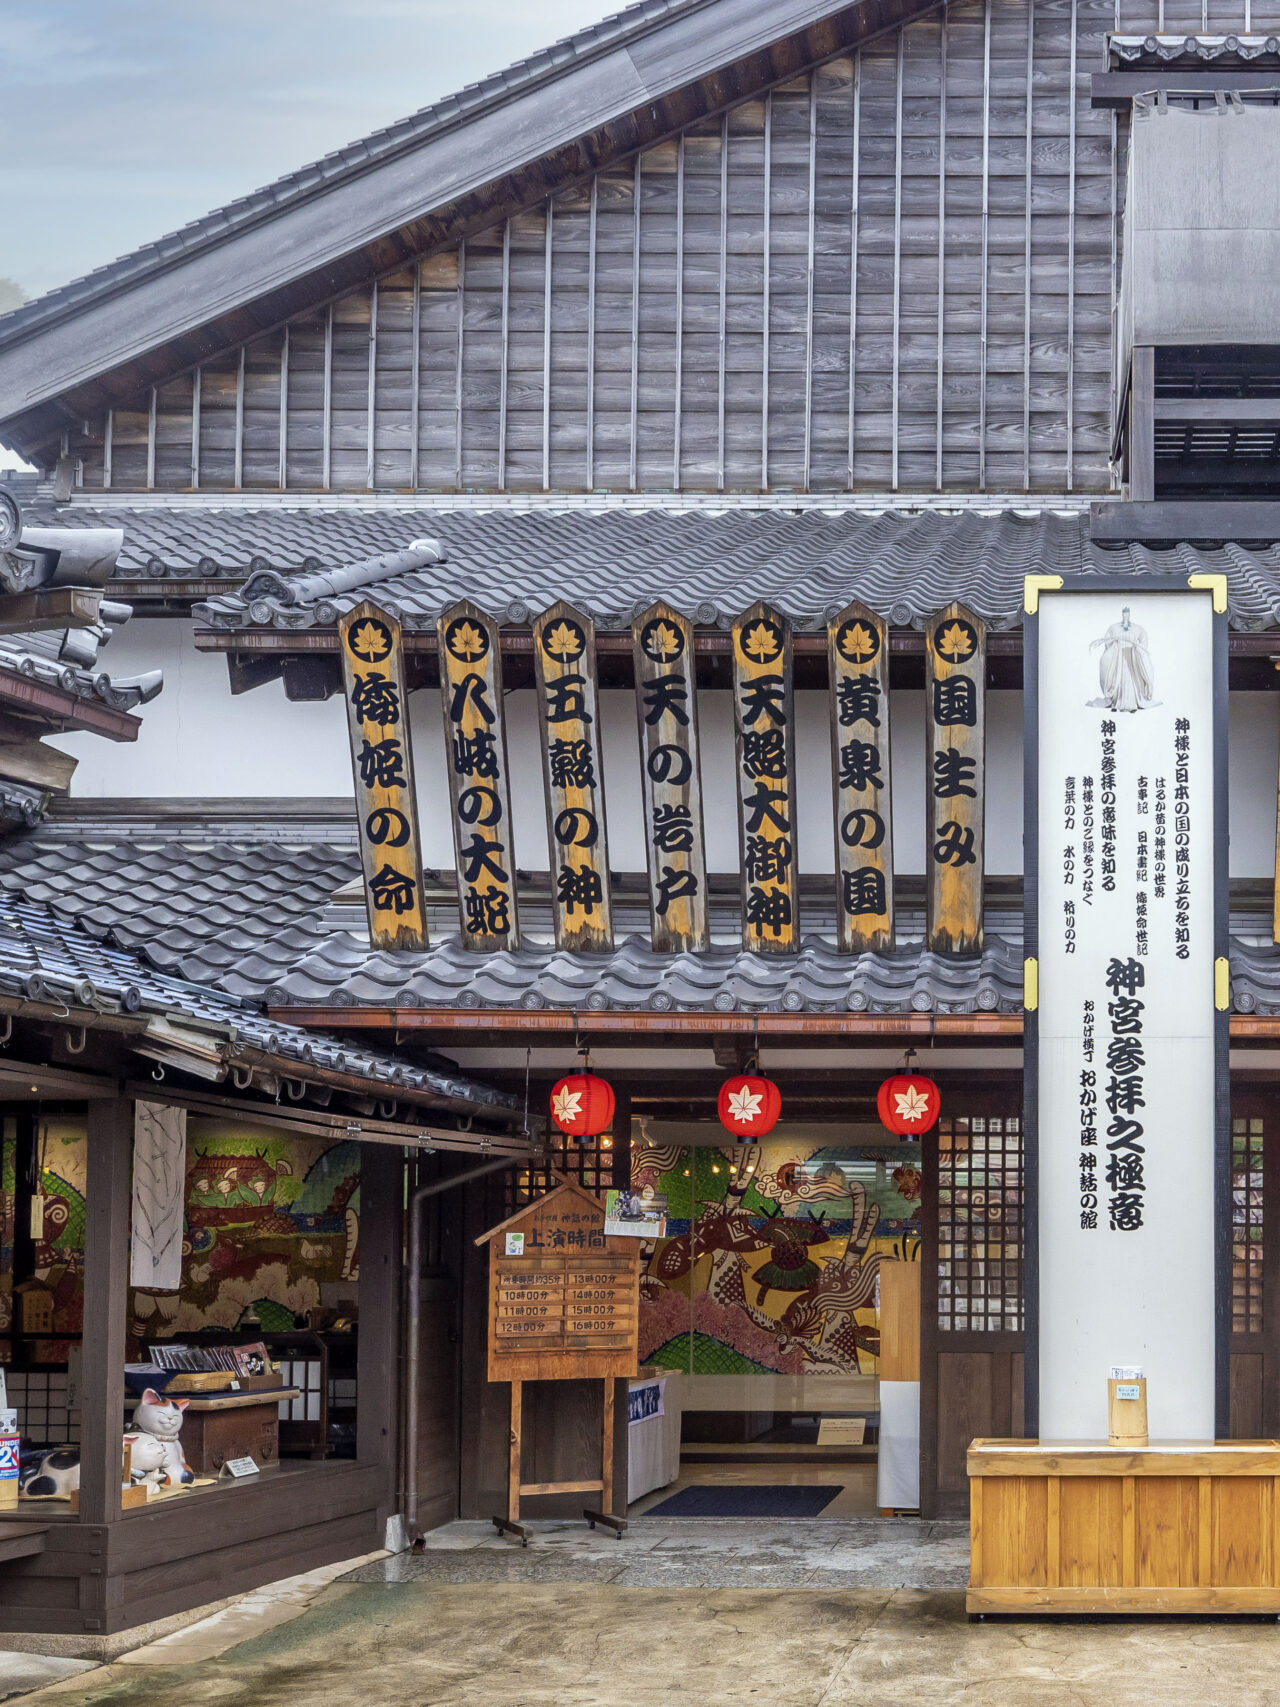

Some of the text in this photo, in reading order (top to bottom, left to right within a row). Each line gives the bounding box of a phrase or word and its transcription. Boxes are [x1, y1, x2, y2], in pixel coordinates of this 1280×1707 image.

[450, 673, 511, 935] 八岐の大蛇
[642, 674, 698, 916] 天の岩戸
[740, 674, 793, 936] 天照大御神
[836, 673, 887, 916] 黄泉の国
[931, 674, 977, 868] 国生み
[1100, 719, 1117, 892] 神宮参拝の意味を知る
[1137, 775, 1149, 814] 古事記
[1063, 776, 1076, 954] 言葉の力 水の力 祈りの力
[1082, 775, 1094, 906] 神様とのご縁をつなぐ
[1153, 777, 1166, 898] はるか昔の神様の世界
[1174, 717, 1191, 960] 神様と日本の国の成り立ちを知る
[1078, 999, 1099, 1230] おかげ横丁 おかげ座 神話の館
[1104, 957, 1146, 1231] 神宮参拝之極意
[504, 1290, 549, 1301] 10時00分
[526, 1228, 607, 1249] 上演時間
[572, 1290, 616, 1300] 14時00分
[573, 1274, 616, 1285] 13時00分
[501, 1322, 545, 1333] 12時00分
[504, 1306, 548, 1316] 11時00分
[572, 1305, 615, 1315] 15時00分
[572, 1321, 615, 1331] 16時00分
